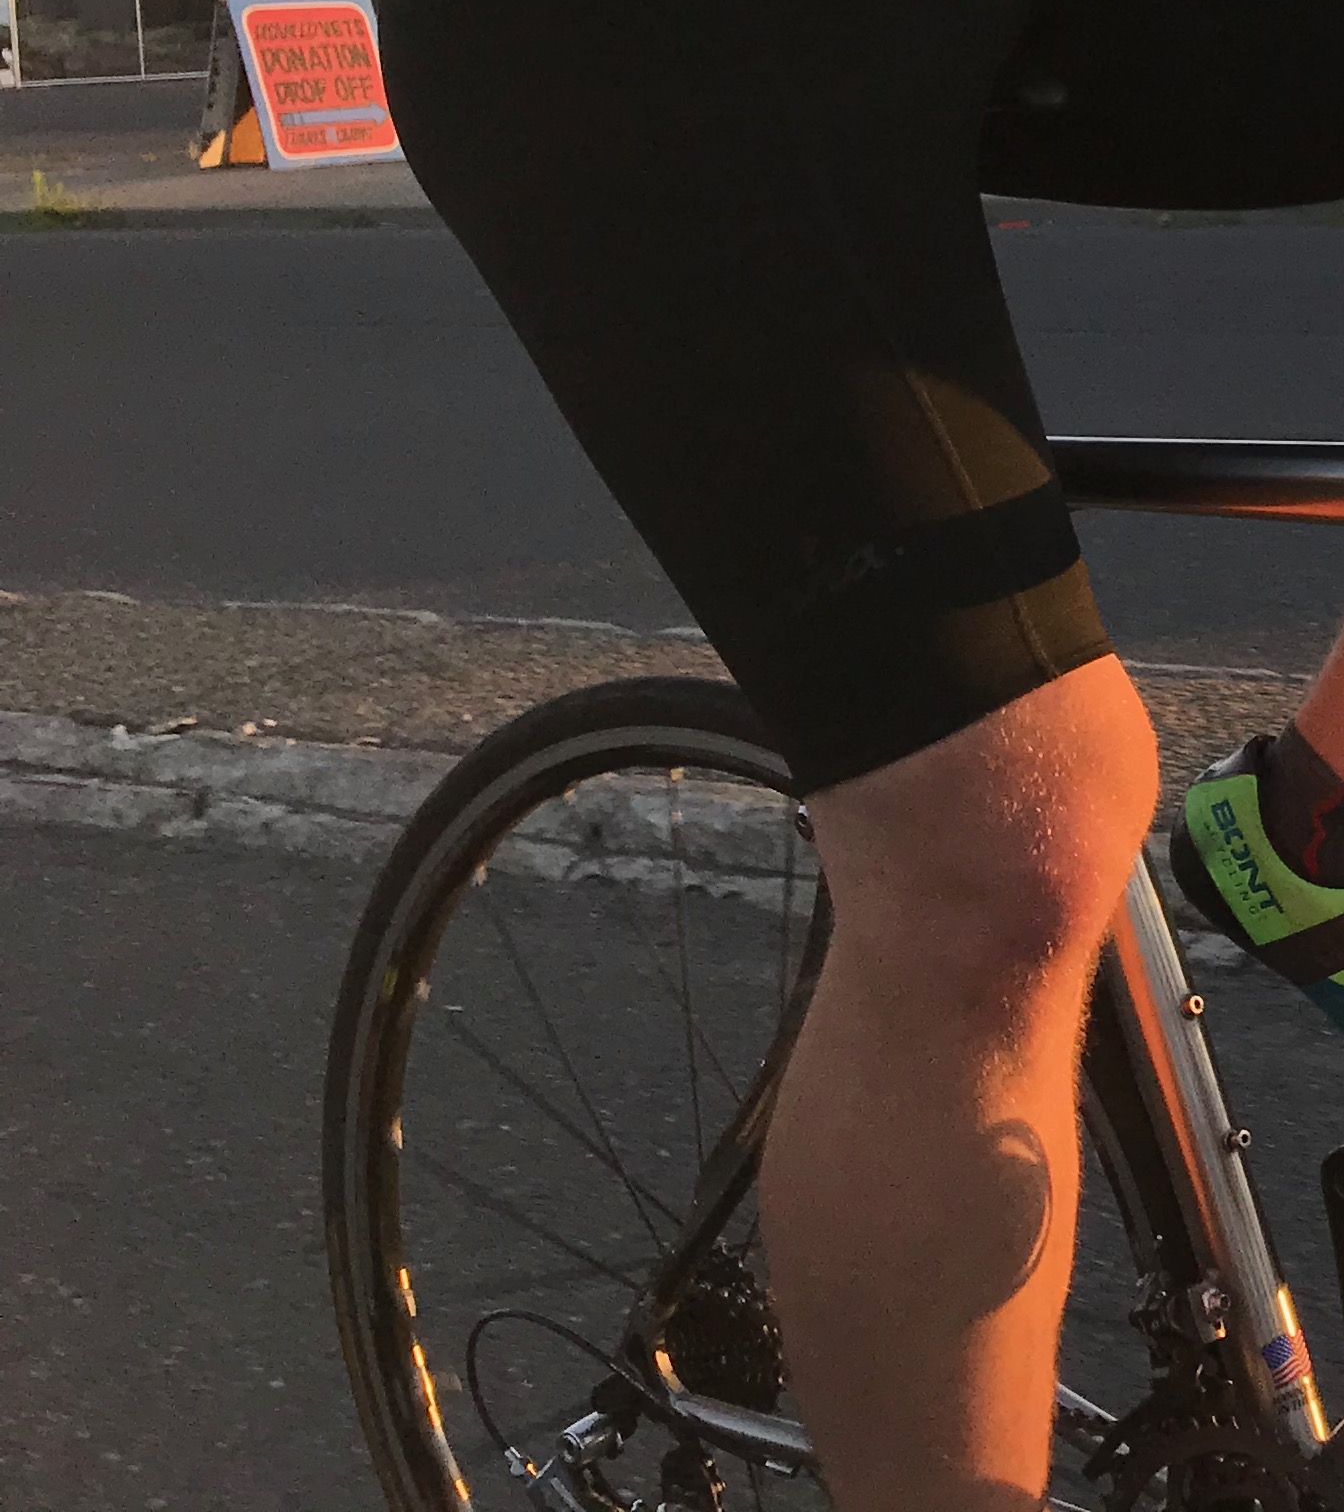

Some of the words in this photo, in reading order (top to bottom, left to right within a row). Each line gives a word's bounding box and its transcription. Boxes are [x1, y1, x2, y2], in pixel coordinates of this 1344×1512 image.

[260, 43, 373, 75] DONATION
[274, 80, 328, 105] DROP
[334, 75, 374, 101] OFF
[1210, 798, 1285, 915] BONT
